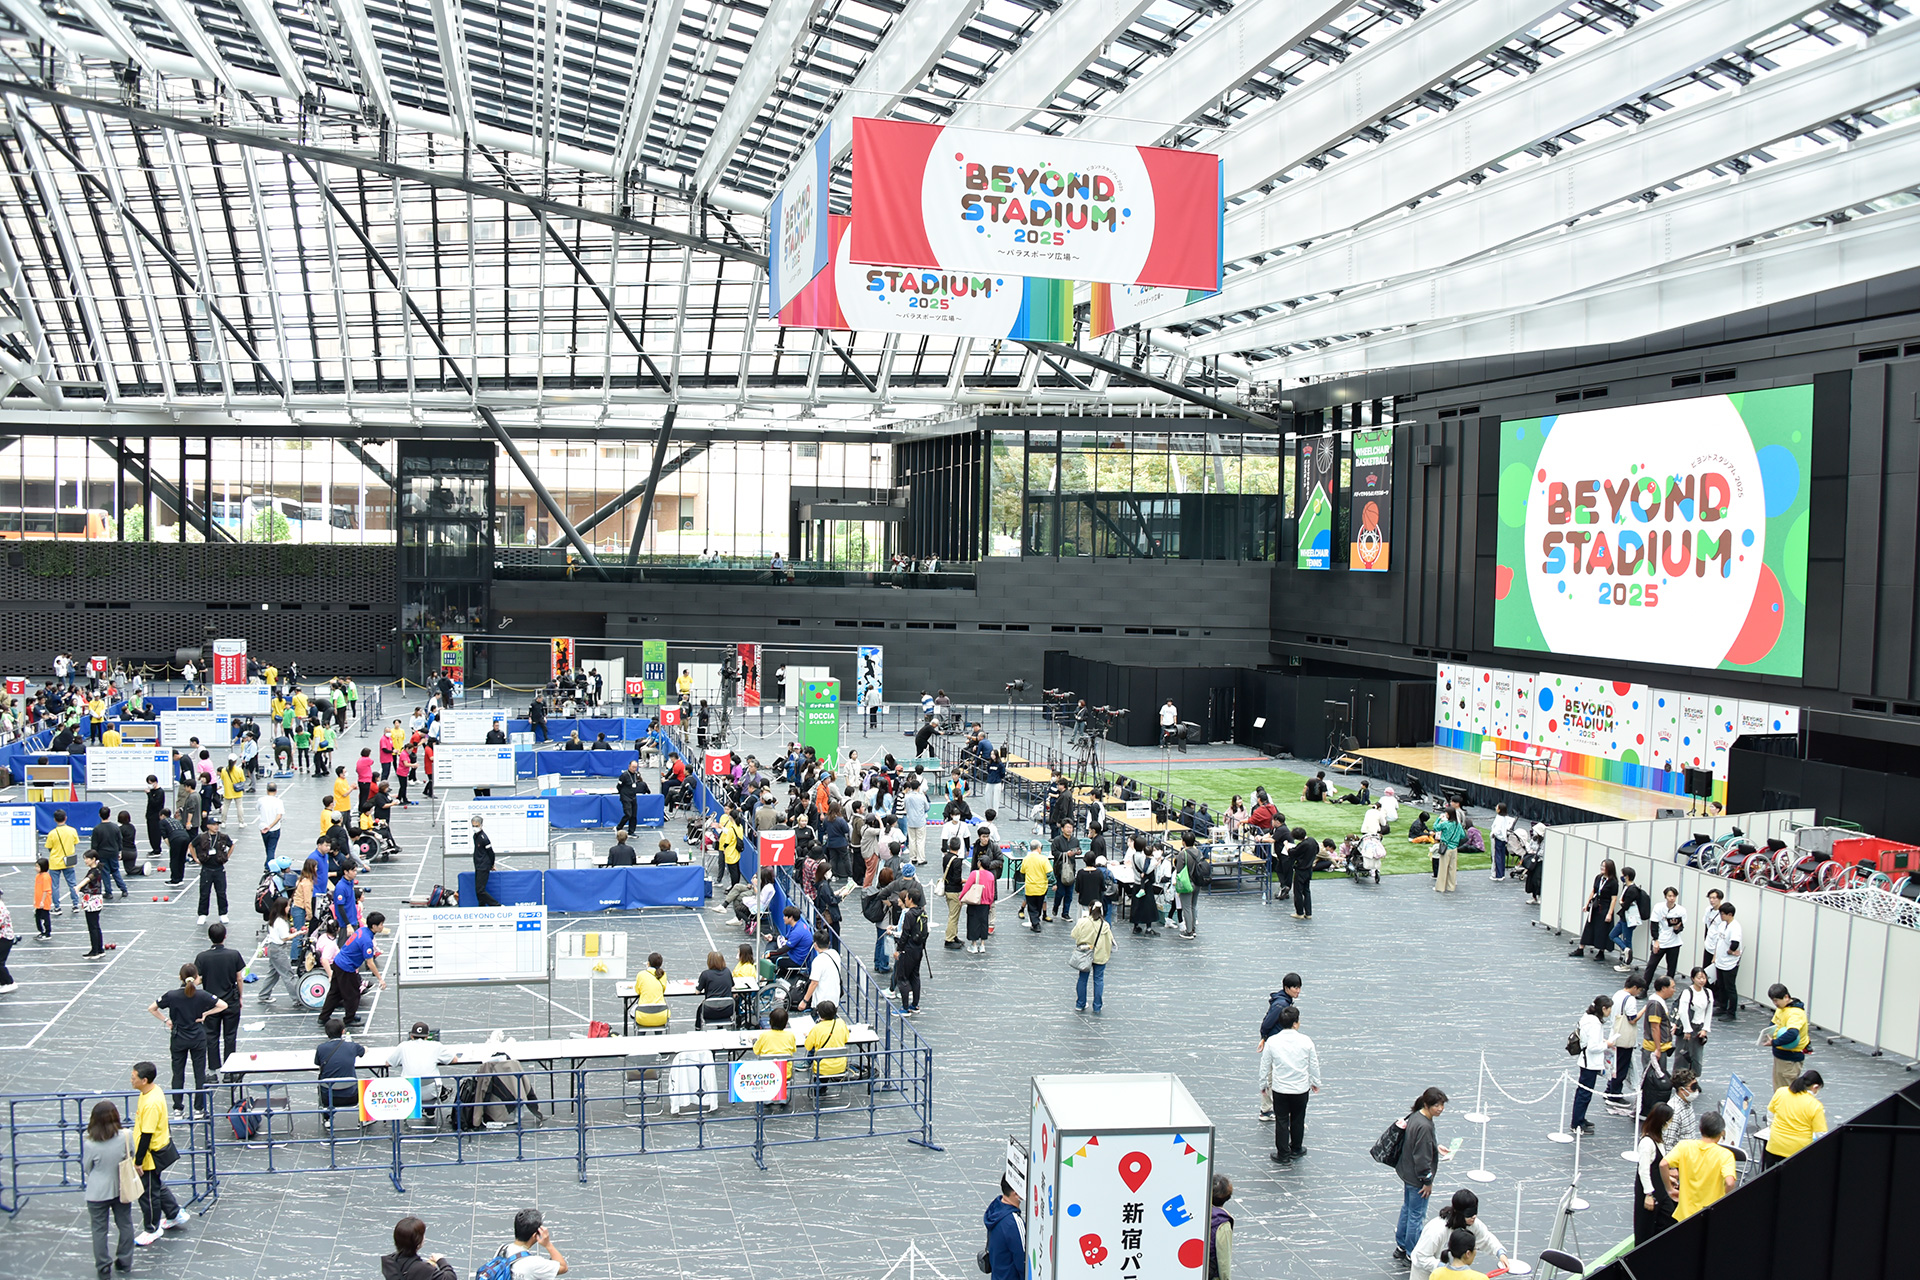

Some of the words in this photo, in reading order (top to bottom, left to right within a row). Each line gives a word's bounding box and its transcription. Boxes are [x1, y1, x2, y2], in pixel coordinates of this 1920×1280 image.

[966, 163, 1115, 202] BEYOND
[785, 184, 811, 235] BEYOND
[961, 193, 1116, 233] STADIUM
[784, 211, 810, 262] STADIUM
[1014, 229, 1065, 246] 2025
[866, 270, 992, 298] STADIUM
[909, 297, 949, 310] 2025
[1355, 445, 1390, 457] WHEELCHAIR
[1355, 456, 1389, 467] BASKETBALL
[1735, 476, 1744, 498] 2025
[1548, 472, 1731, 525] BEYOND
[1300, 549, 1329, 557] WHEELCHAIR
[1542, 529, 1732, 578] STADIUM
[1306, 559, 1322, 568] TENNIS
[1599, 582, 1659, 607] 2025
[96, 661, 103, 670] 6
[645, 663, 663, 672] QUIZ
[645, 672, 664, 680] TIME
[12, 683, 20, 693] 5
[628, 683, 641, 693] 10
[1565, 699, 1613, 718] BEYOND
[666, 712, 675, 723] 9
[808, 712, 835, 720] BOCCIA
[1563, 713, 1614, 733] STADIUM
[1579, 730, 1596, 739] 2025
[712, 758, 723, 773] 8
[770, 843, 784, 862] 7
[740, 1073, 776, 1081] BEYOND
[372, 1090, 409, 1098] BEYOND
[371, 1097, 410, 1105] STADIUM
[1120, 1202, 1144, 1280] 新宿パ
